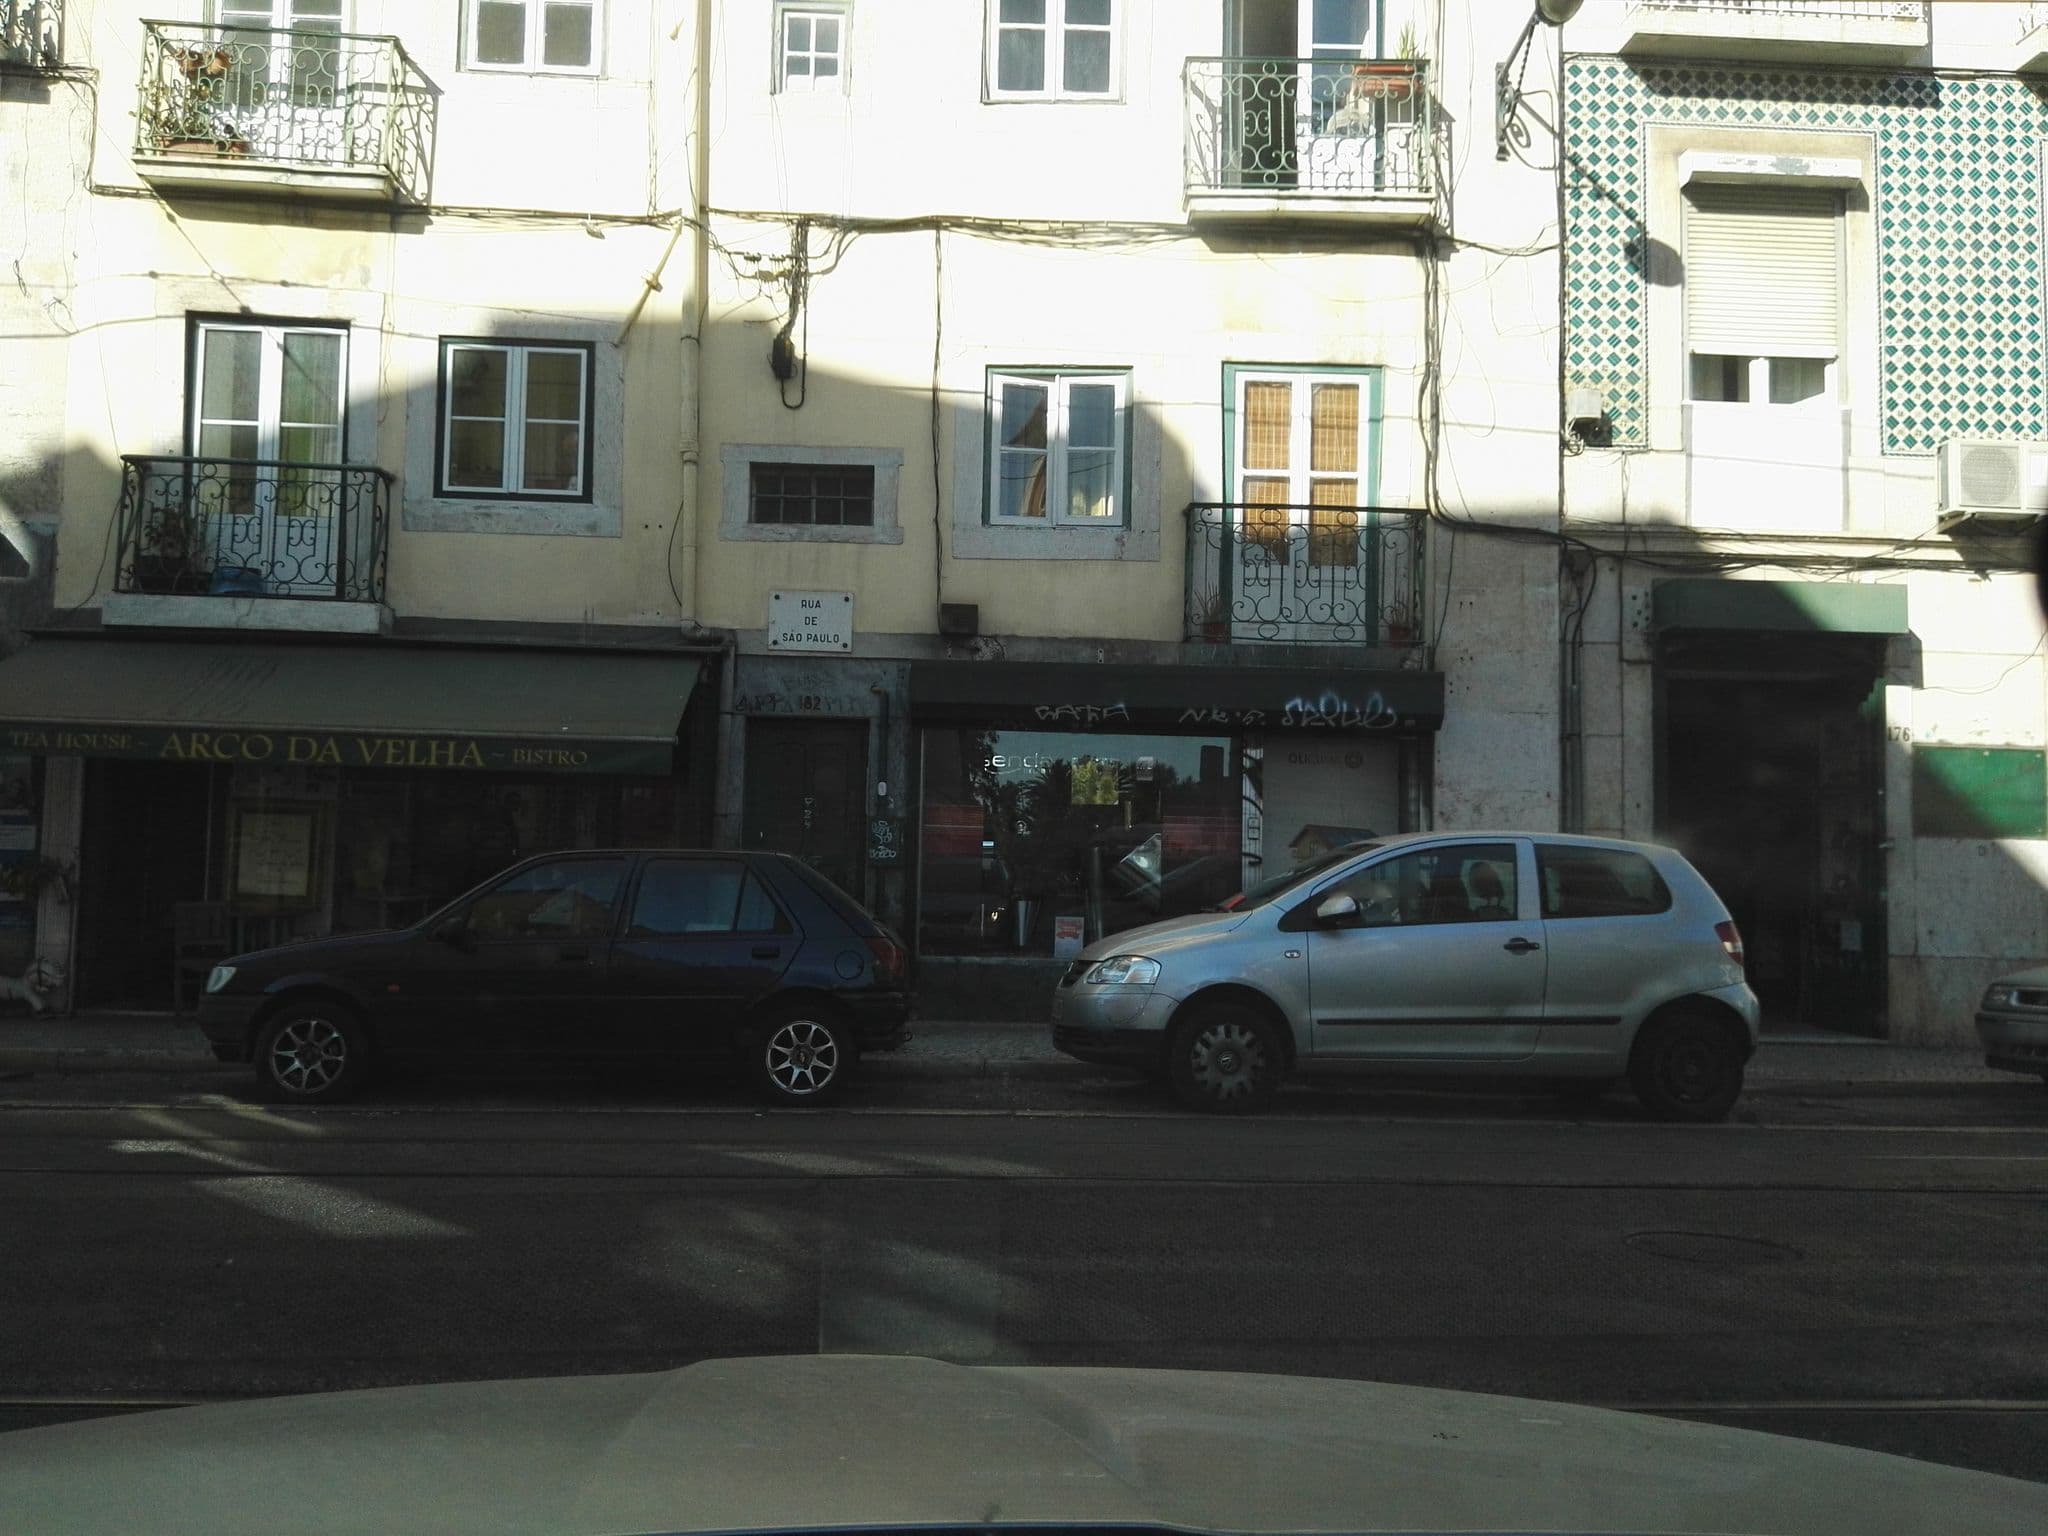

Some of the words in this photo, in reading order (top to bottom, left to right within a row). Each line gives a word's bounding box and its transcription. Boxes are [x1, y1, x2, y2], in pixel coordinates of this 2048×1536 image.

[801, 599, 822, 609] RUA
[804, 616, 818, 626] DE
[806, 633, 840, 643] PAULO
[1887, 726, 1911, 742] 176
[11, 731, 49, 747] TEA
[56, 732, 133, 750] HOUSE
[160, 731, 275, 761] ARCO
[286, 735, 345, 764] DA
[353, 737, 486, 768] VELHA
[511, 746, 589, 766] BISTRO
